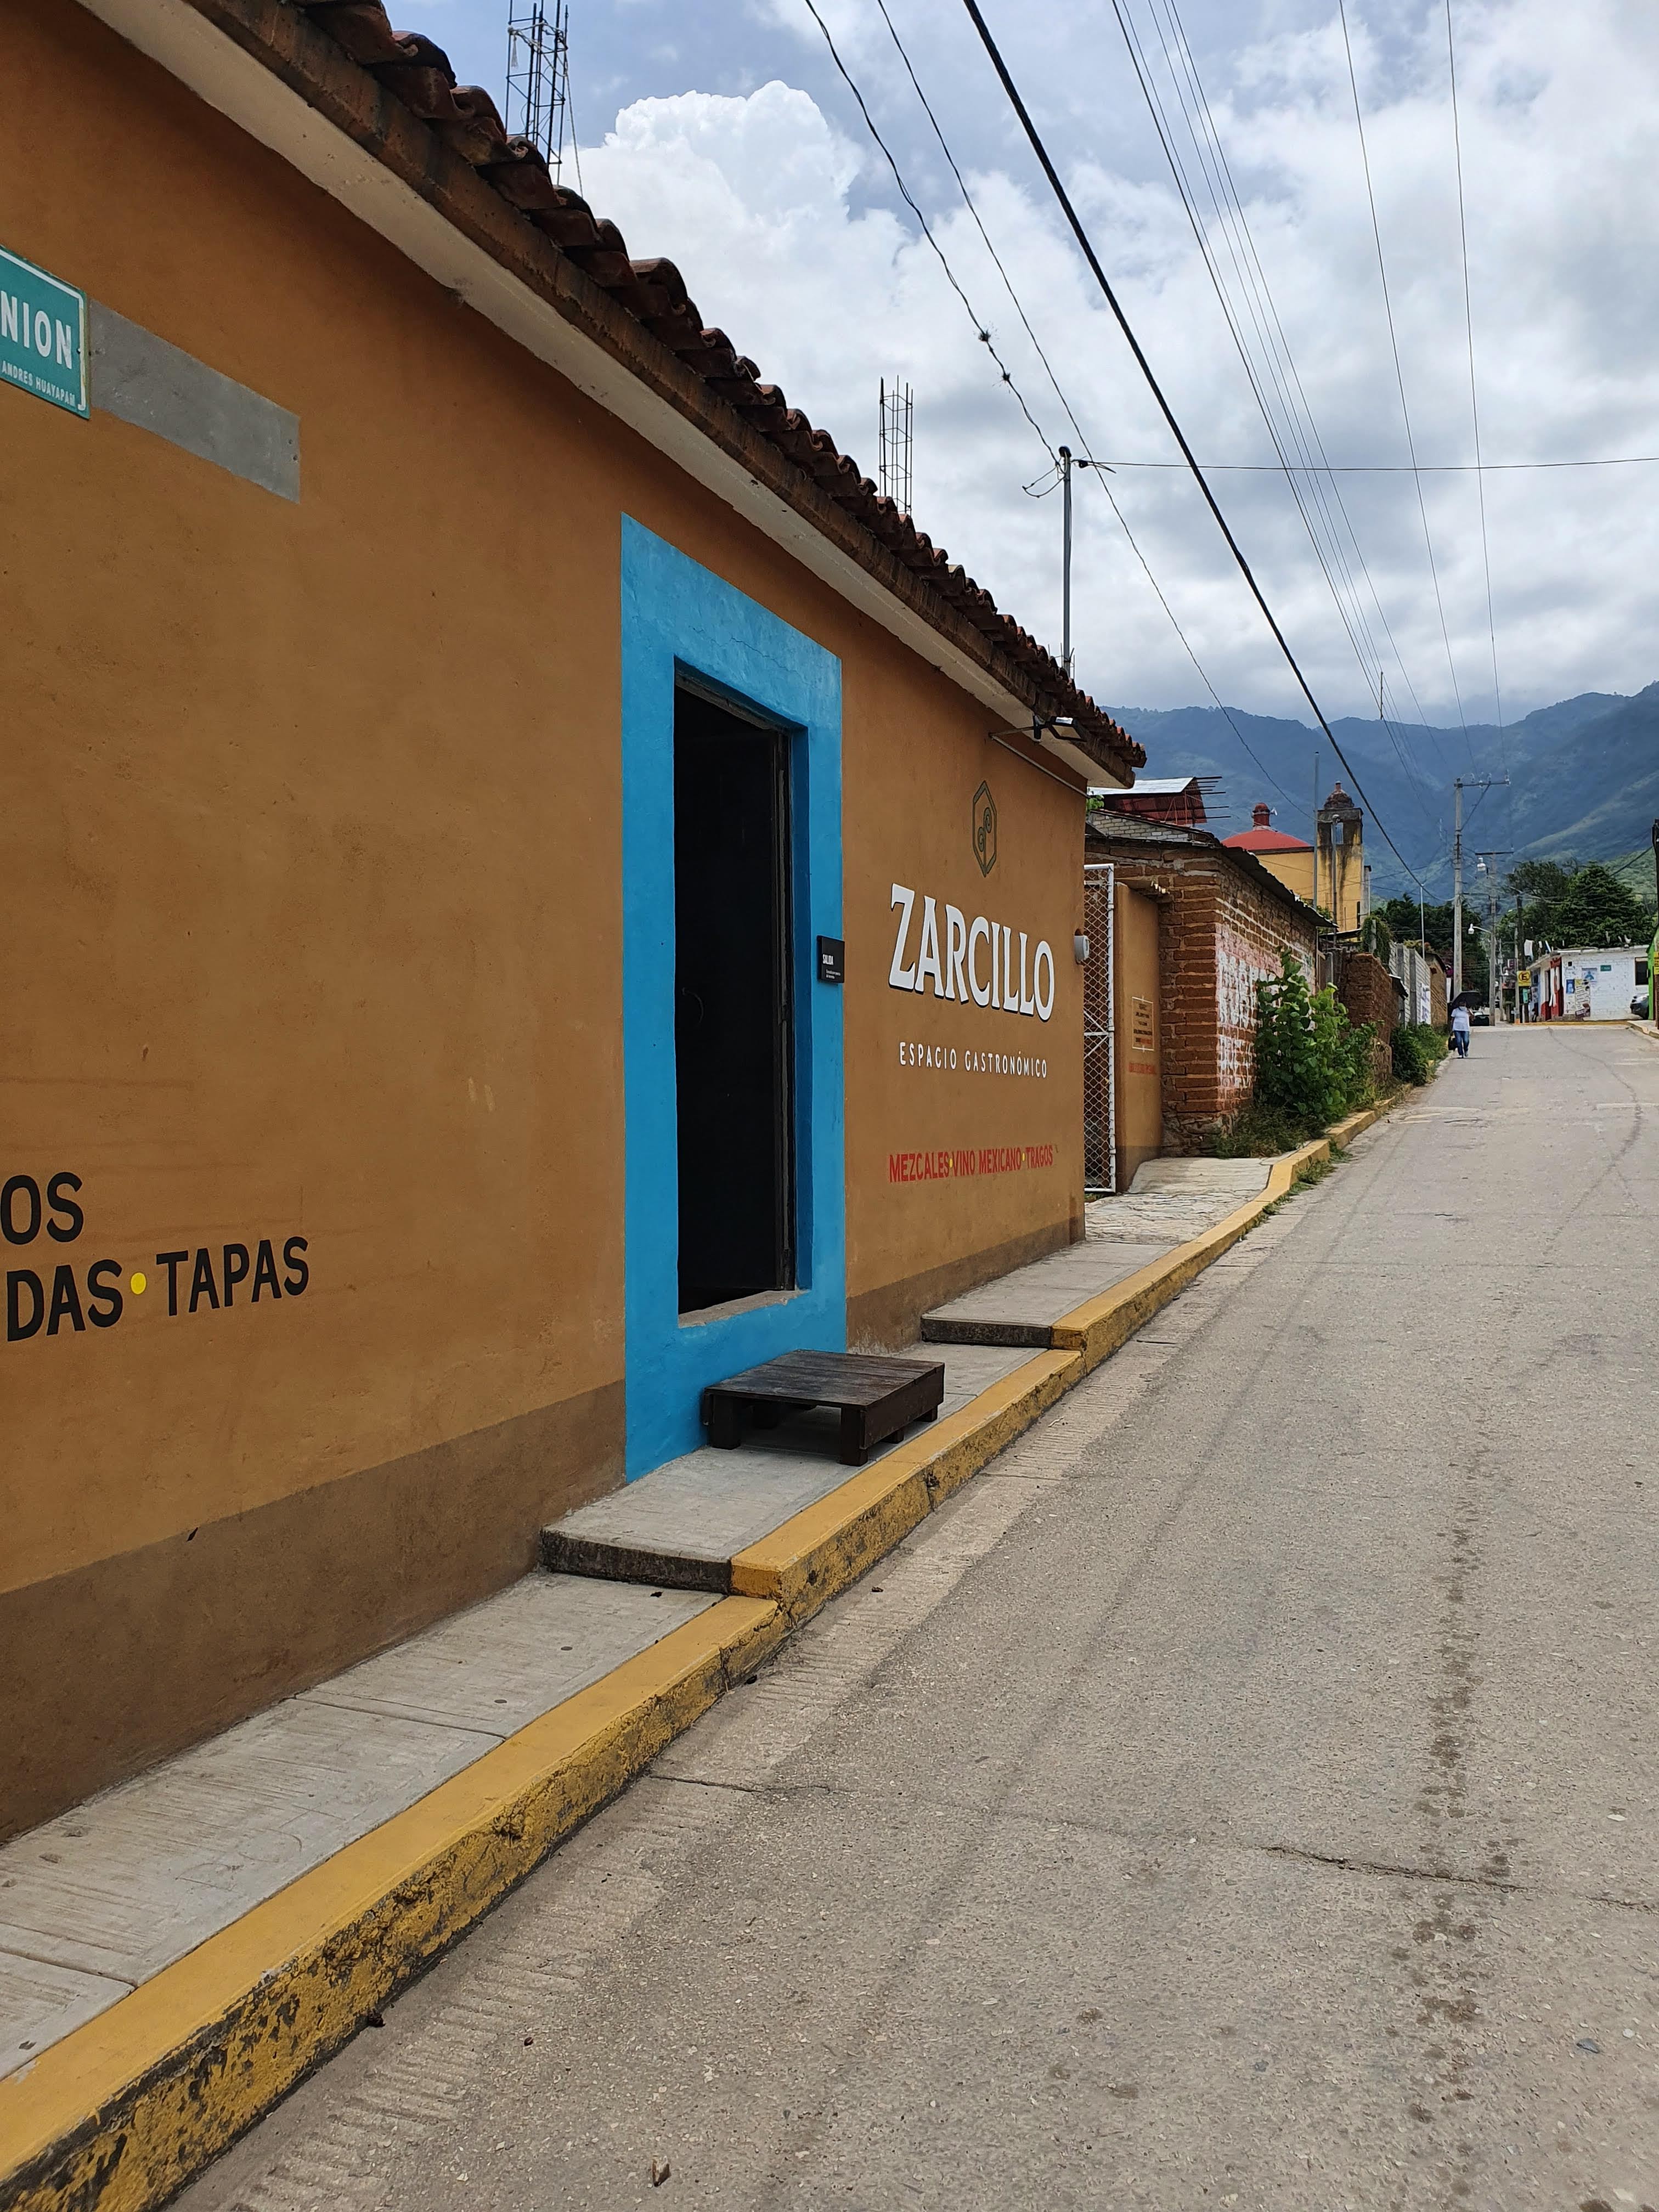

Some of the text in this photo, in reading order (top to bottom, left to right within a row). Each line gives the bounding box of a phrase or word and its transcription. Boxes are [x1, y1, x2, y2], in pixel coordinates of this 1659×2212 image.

[1, 290, 72, 369] NION
[2, 360, 76, 407] ANDRES HUAYAPAM
[822, 953, 833, 965] SALIDA
[889, 883, 1054, 1022] ZARCILLO
[900, 1042, 1047, 1078] ESPACIO GASTRONÓMICO
[889, 1144, 1053, 1183] MEZCALES VINO MEXICANO TRAGOS
[1, 1172, 84, 1245] OS
[7, 1236, 309, 1341] DAS TAPAS
